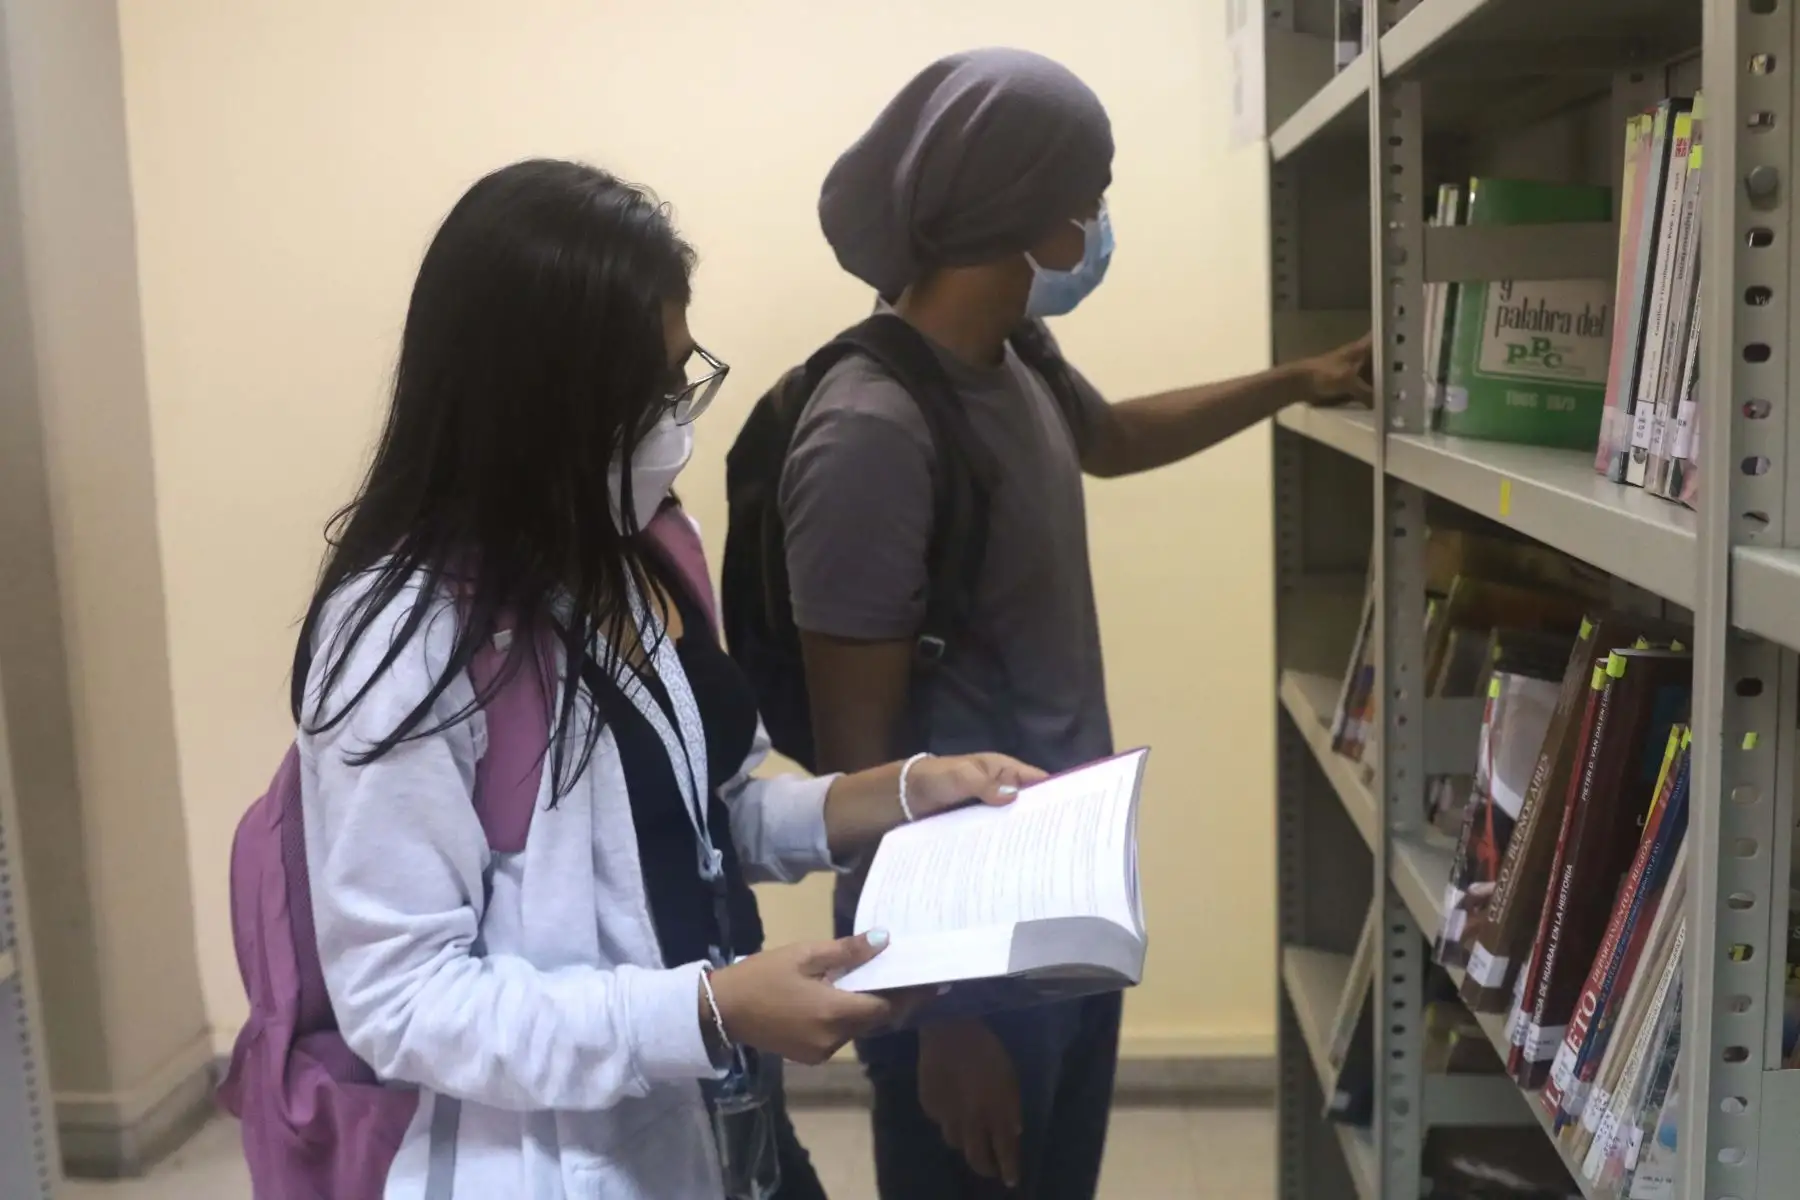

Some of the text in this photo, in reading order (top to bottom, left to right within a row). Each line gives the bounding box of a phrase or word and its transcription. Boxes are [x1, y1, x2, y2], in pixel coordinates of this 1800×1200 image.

[1494, 296, 1607, 338] palabra del
[1504, 336, 1563, 369] PPC
[1591, 737, 1600, 758] VAN
[1487, 868, 1510, 923] CUZCO
[1508, 800, 1533, 860] BUENOS
[1531, 753, 1549, 798] AIRES
[1538, 980, 1547, 997] DE
[1543, 943, 1556, 983] HUARAL
[1551, 925, 1560, 942] EN
[1557, 863, 1574, 910] HISTORIA
